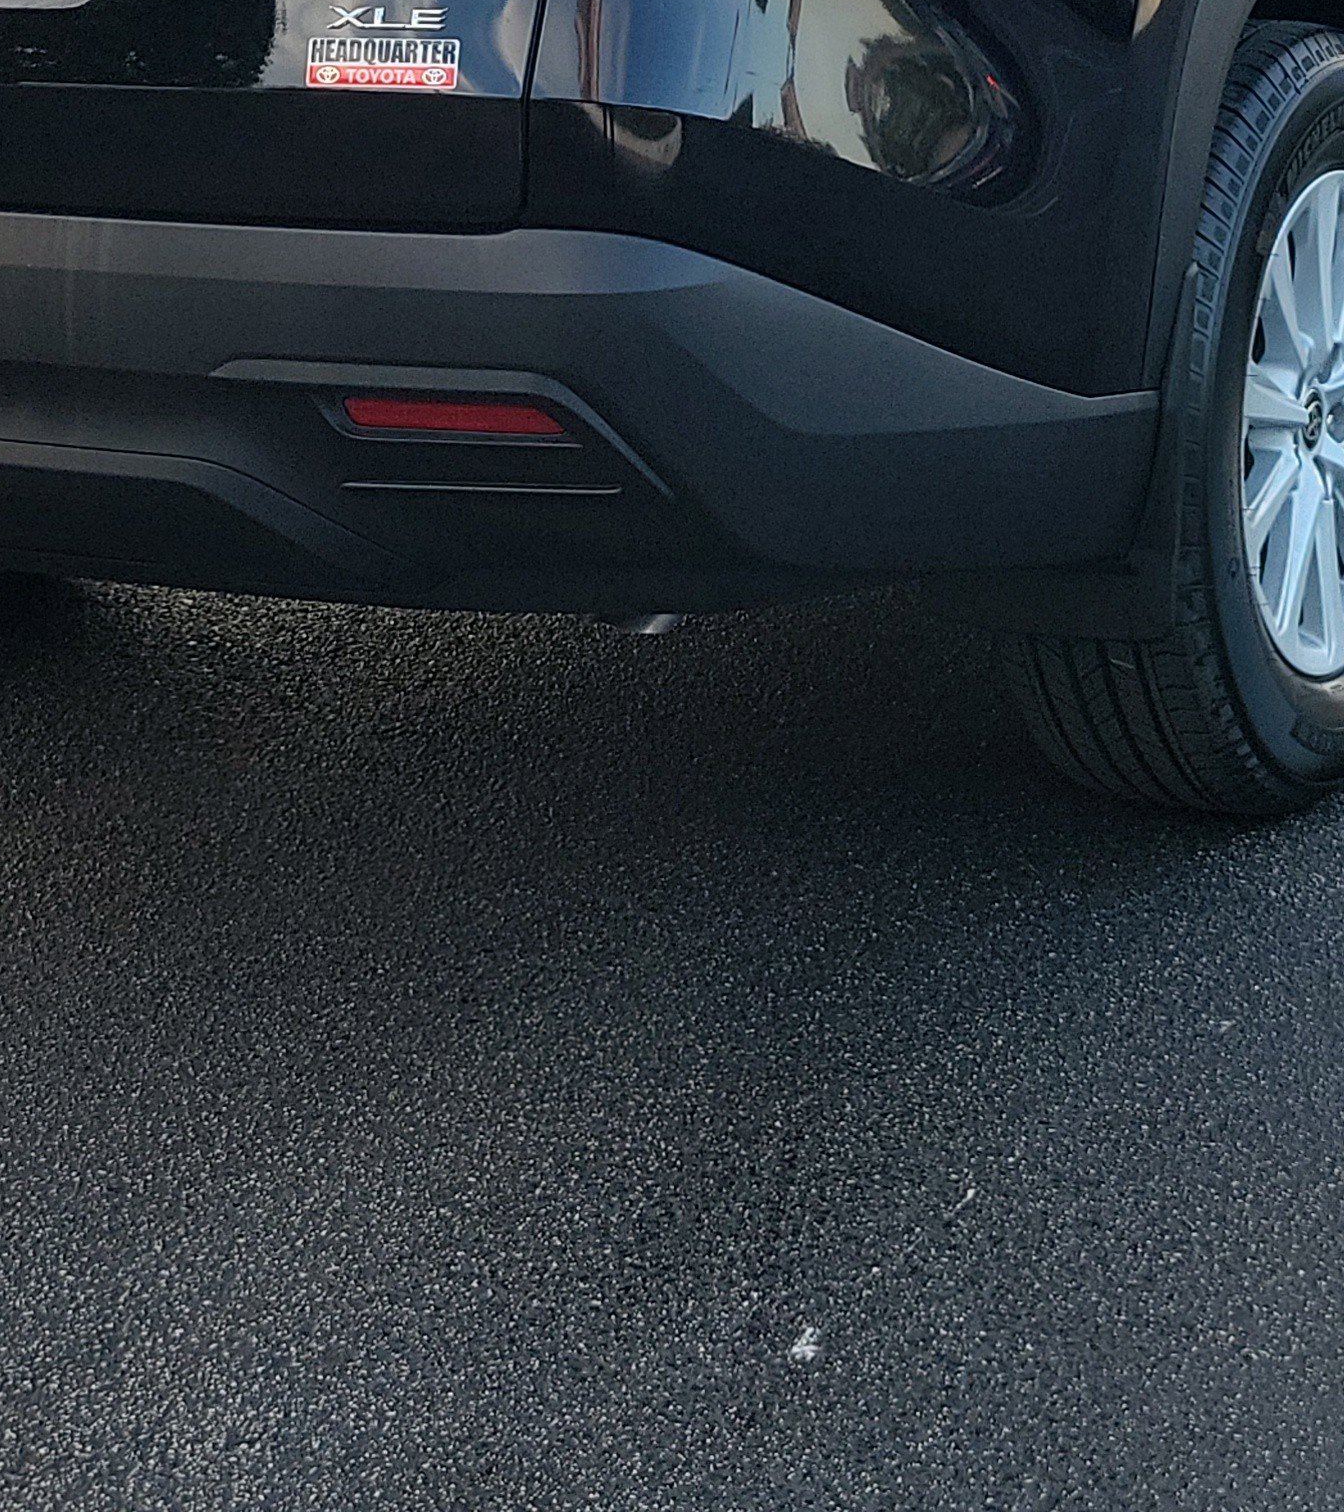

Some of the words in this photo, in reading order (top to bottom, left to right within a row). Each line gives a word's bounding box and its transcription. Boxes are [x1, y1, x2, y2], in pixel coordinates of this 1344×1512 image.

[326, 5, 449, 31] XLE
[311, 39, 457, 65] HEADQUARTER
[344, 68, 417, 85] TOYOTA
